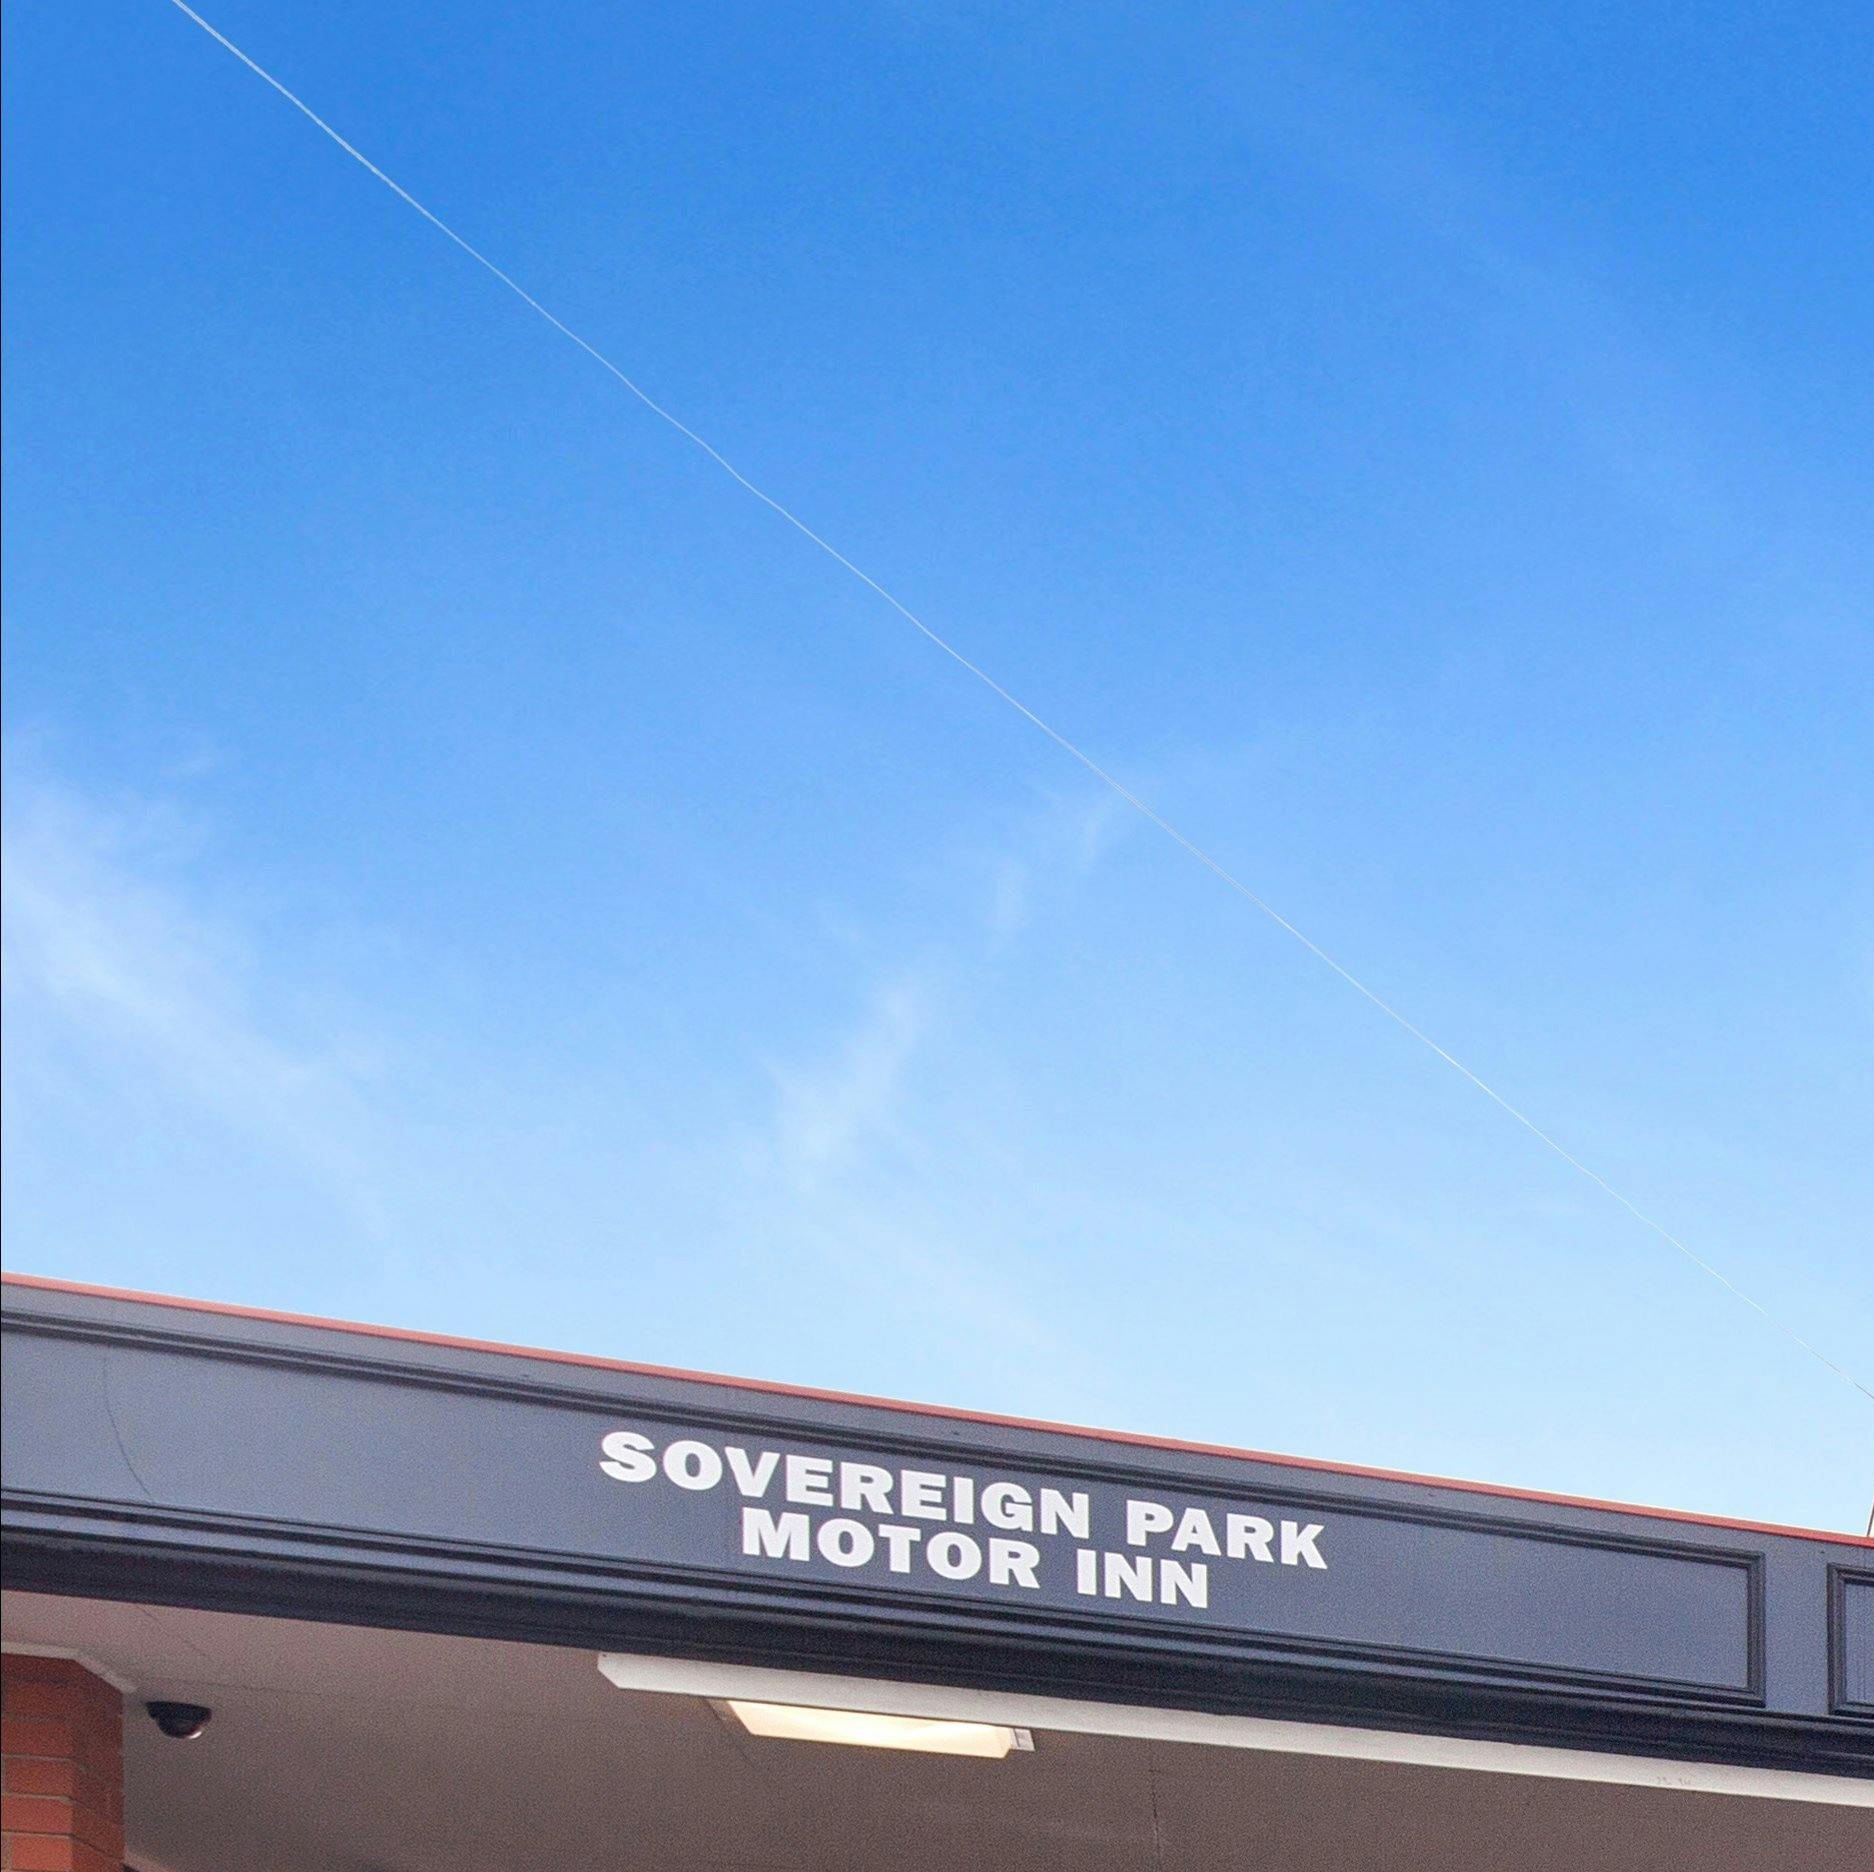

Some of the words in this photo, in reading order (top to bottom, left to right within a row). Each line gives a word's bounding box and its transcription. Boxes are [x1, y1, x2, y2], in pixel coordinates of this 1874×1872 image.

[599, 1431, 1090, 1540] SOVEREIGN
[1125, 1499, 1328, 1570] PARK
[741, 1506, 1041, 1590] MOTOR
[1076, 1548, 1209, 1609] INN
